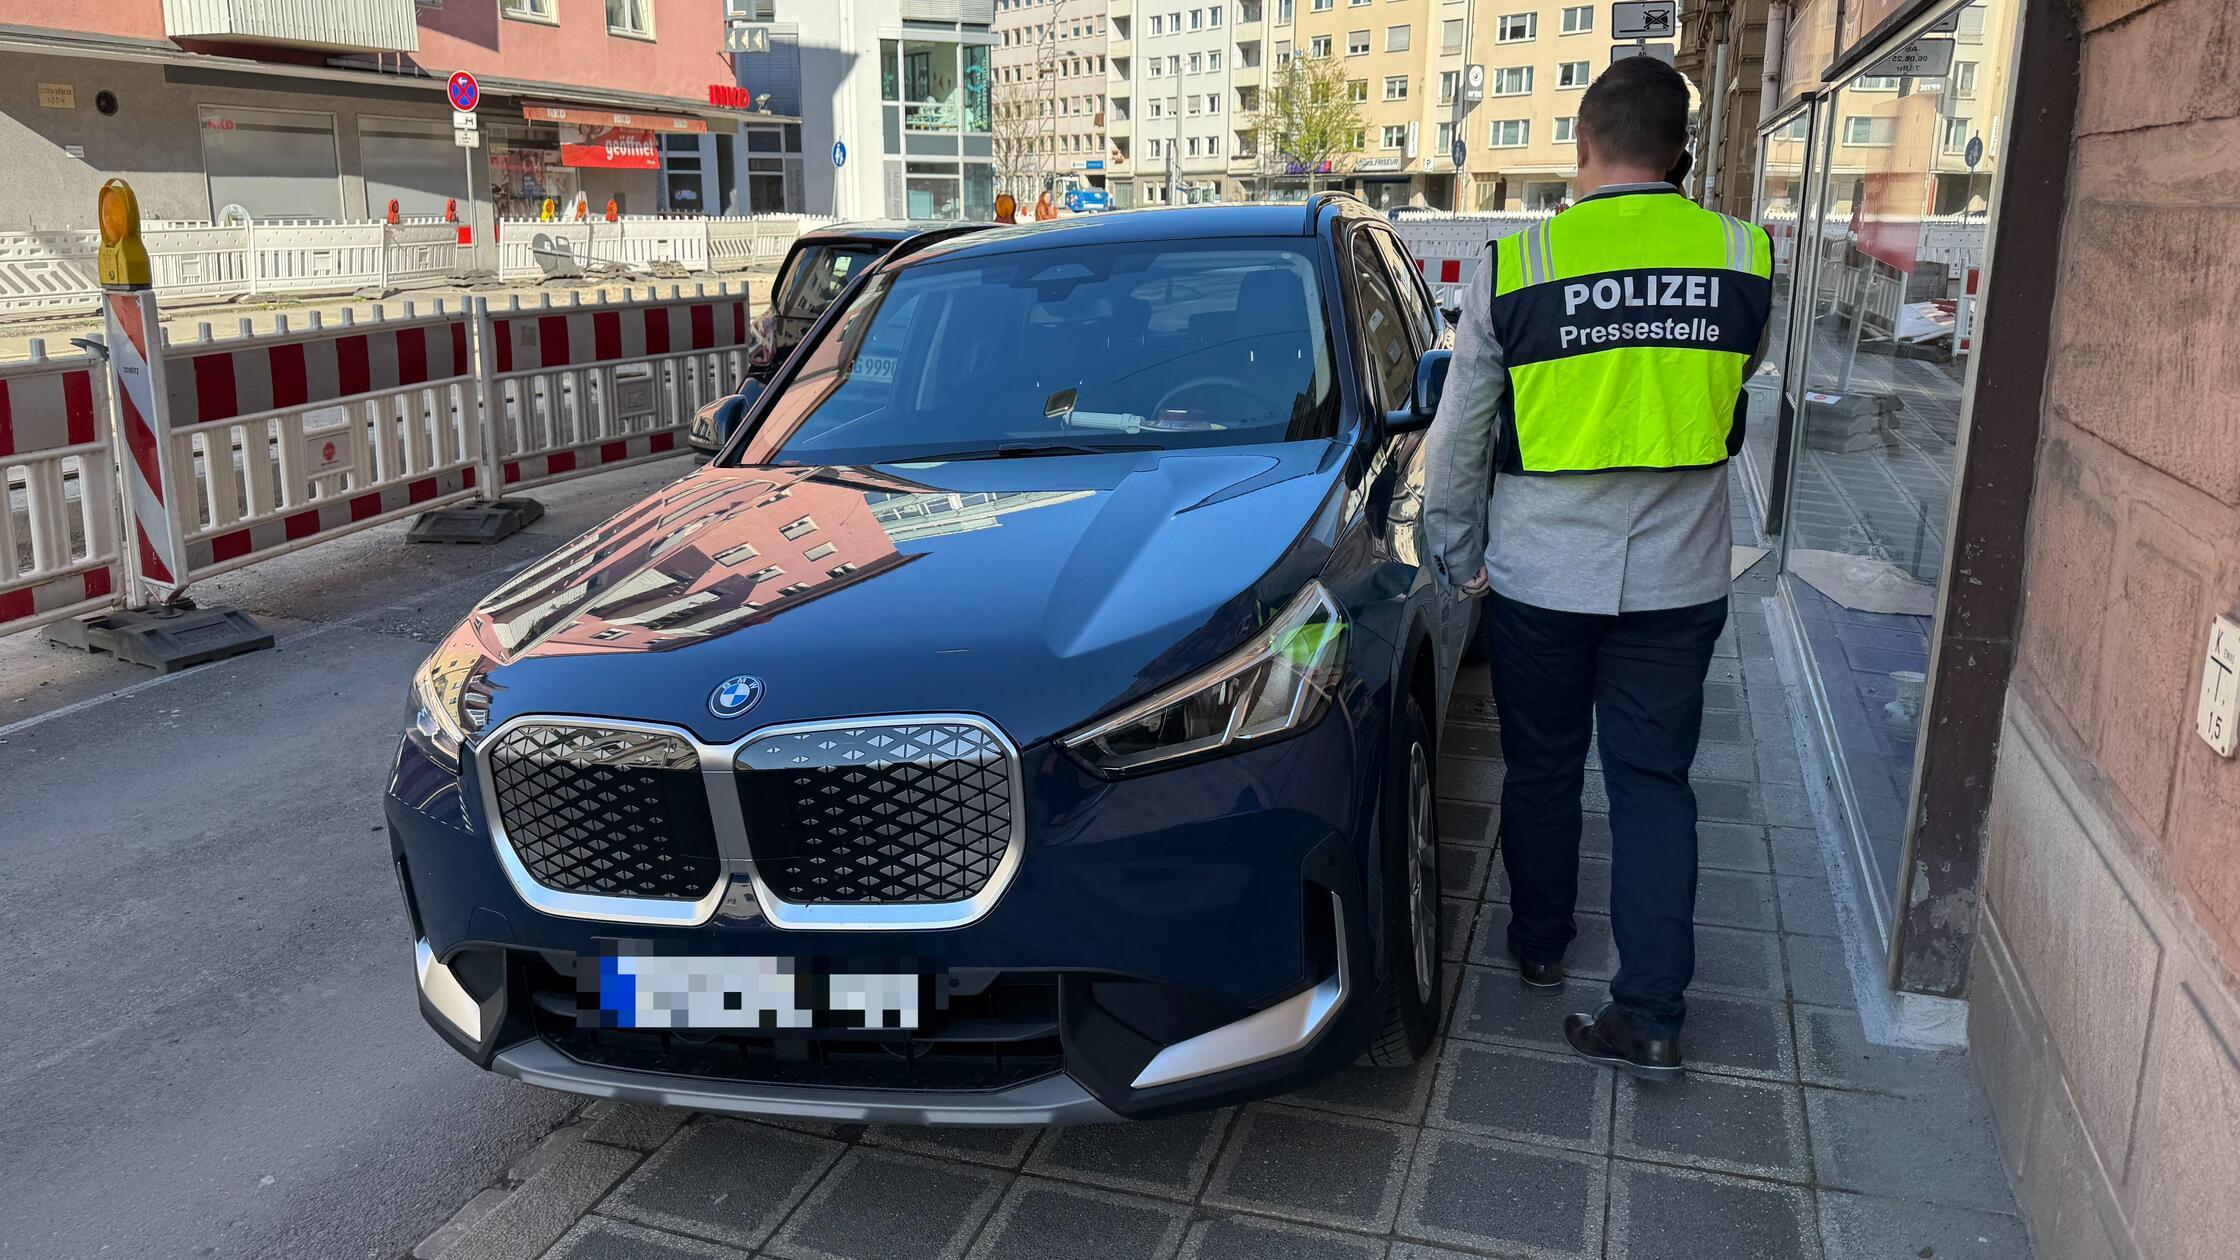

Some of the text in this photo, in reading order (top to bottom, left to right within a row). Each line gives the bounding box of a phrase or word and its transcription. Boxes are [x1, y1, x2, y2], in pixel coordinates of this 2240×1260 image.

[547, 108, 566, 119] NKD
[614, 113, 631, 125] NKD
[605, 135, 655, 161] geöffnet
[1564, 275, 1720, 316] POLIZEI
[1559, 317, 1720, 349] Pressestelle
